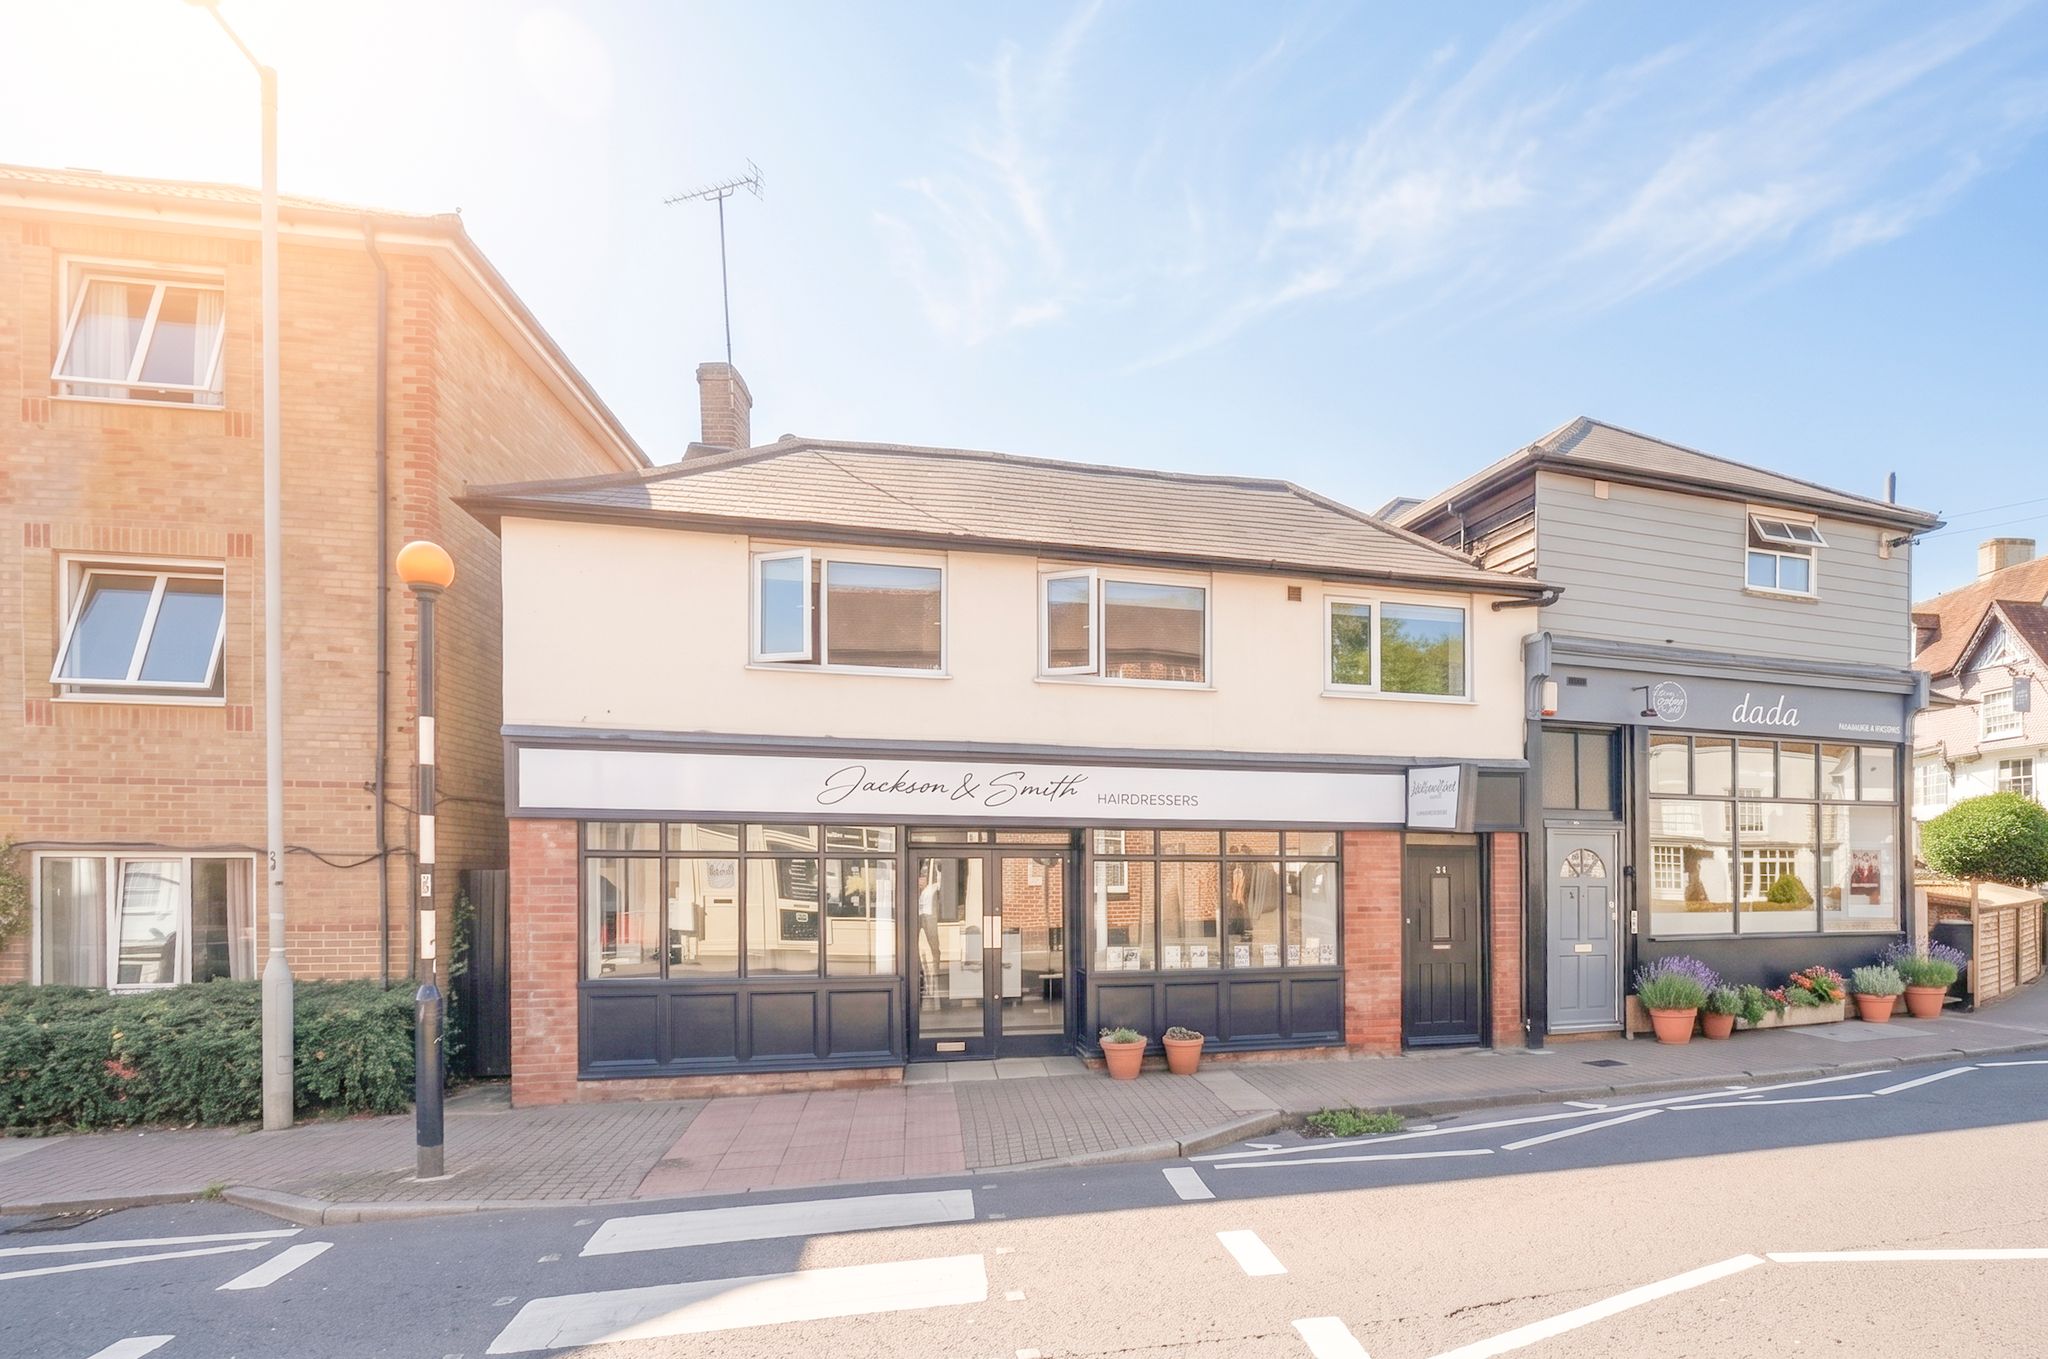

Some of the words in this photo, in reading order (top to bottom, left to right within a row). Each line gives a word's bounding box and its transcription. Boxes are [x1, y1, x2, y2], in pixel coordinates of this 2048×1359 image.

[1732, 692, 1800, 727] dada
[816, 765, 949, 805] Jackson
[950, 772, 981, 801] &
[984, 771, 1089, 807] Smith
[1097, 793, 1199, 807] HAIRDRESSERS
